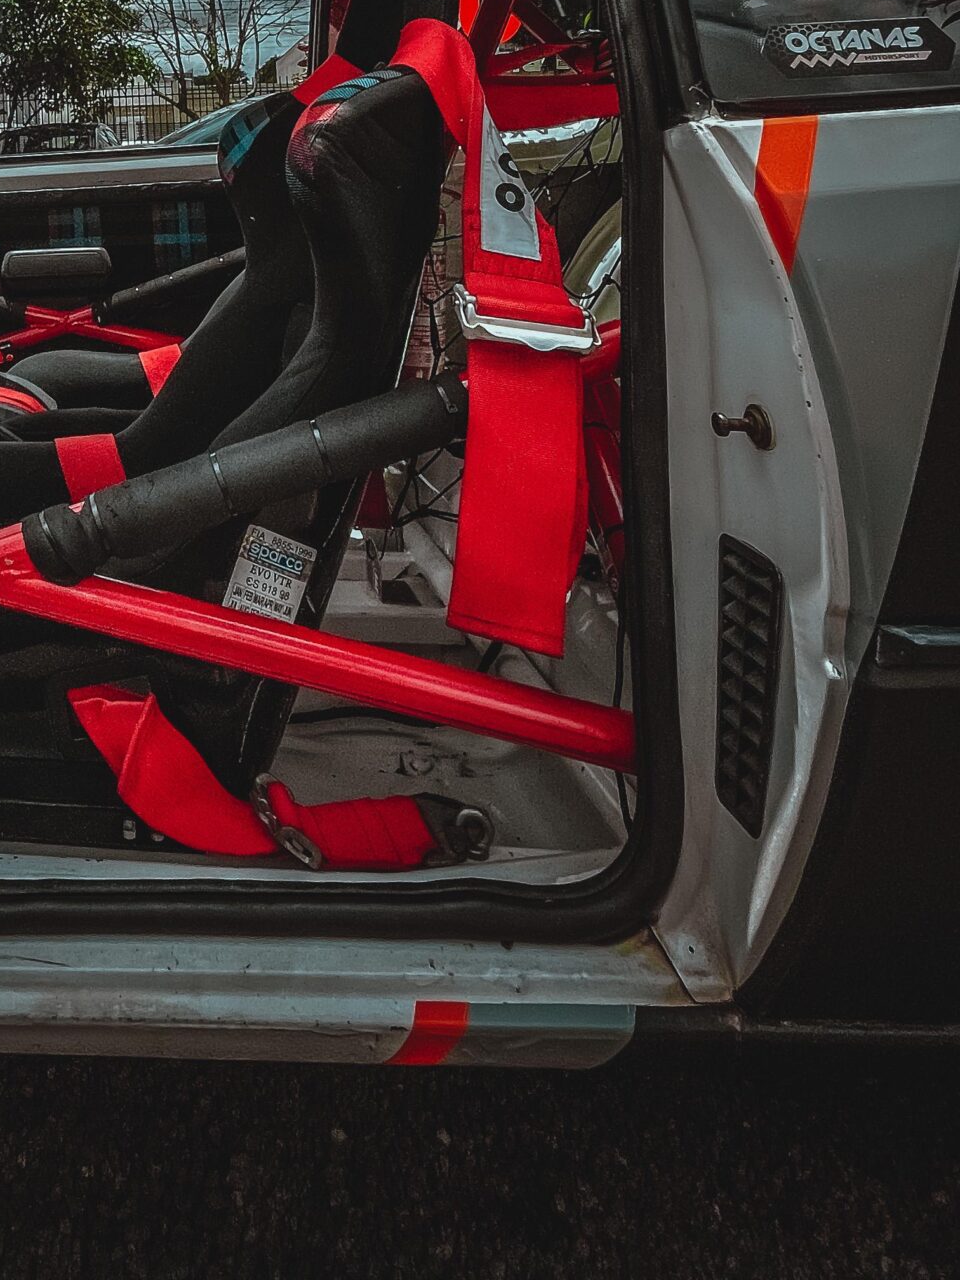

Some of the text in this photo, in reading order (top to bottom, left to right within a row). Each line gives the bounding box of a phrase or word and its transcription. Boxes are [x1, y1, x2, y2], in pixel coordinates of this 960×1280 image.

[784, 26, 924, 54] OCTANAS
[863, 53, 921, 62] MOTORSPORT
[249, 541, 304, 572] sparco
[251, 528, 313, 559] FIA 8855-1999
[249, 564, 293, 589] EVO VTR
